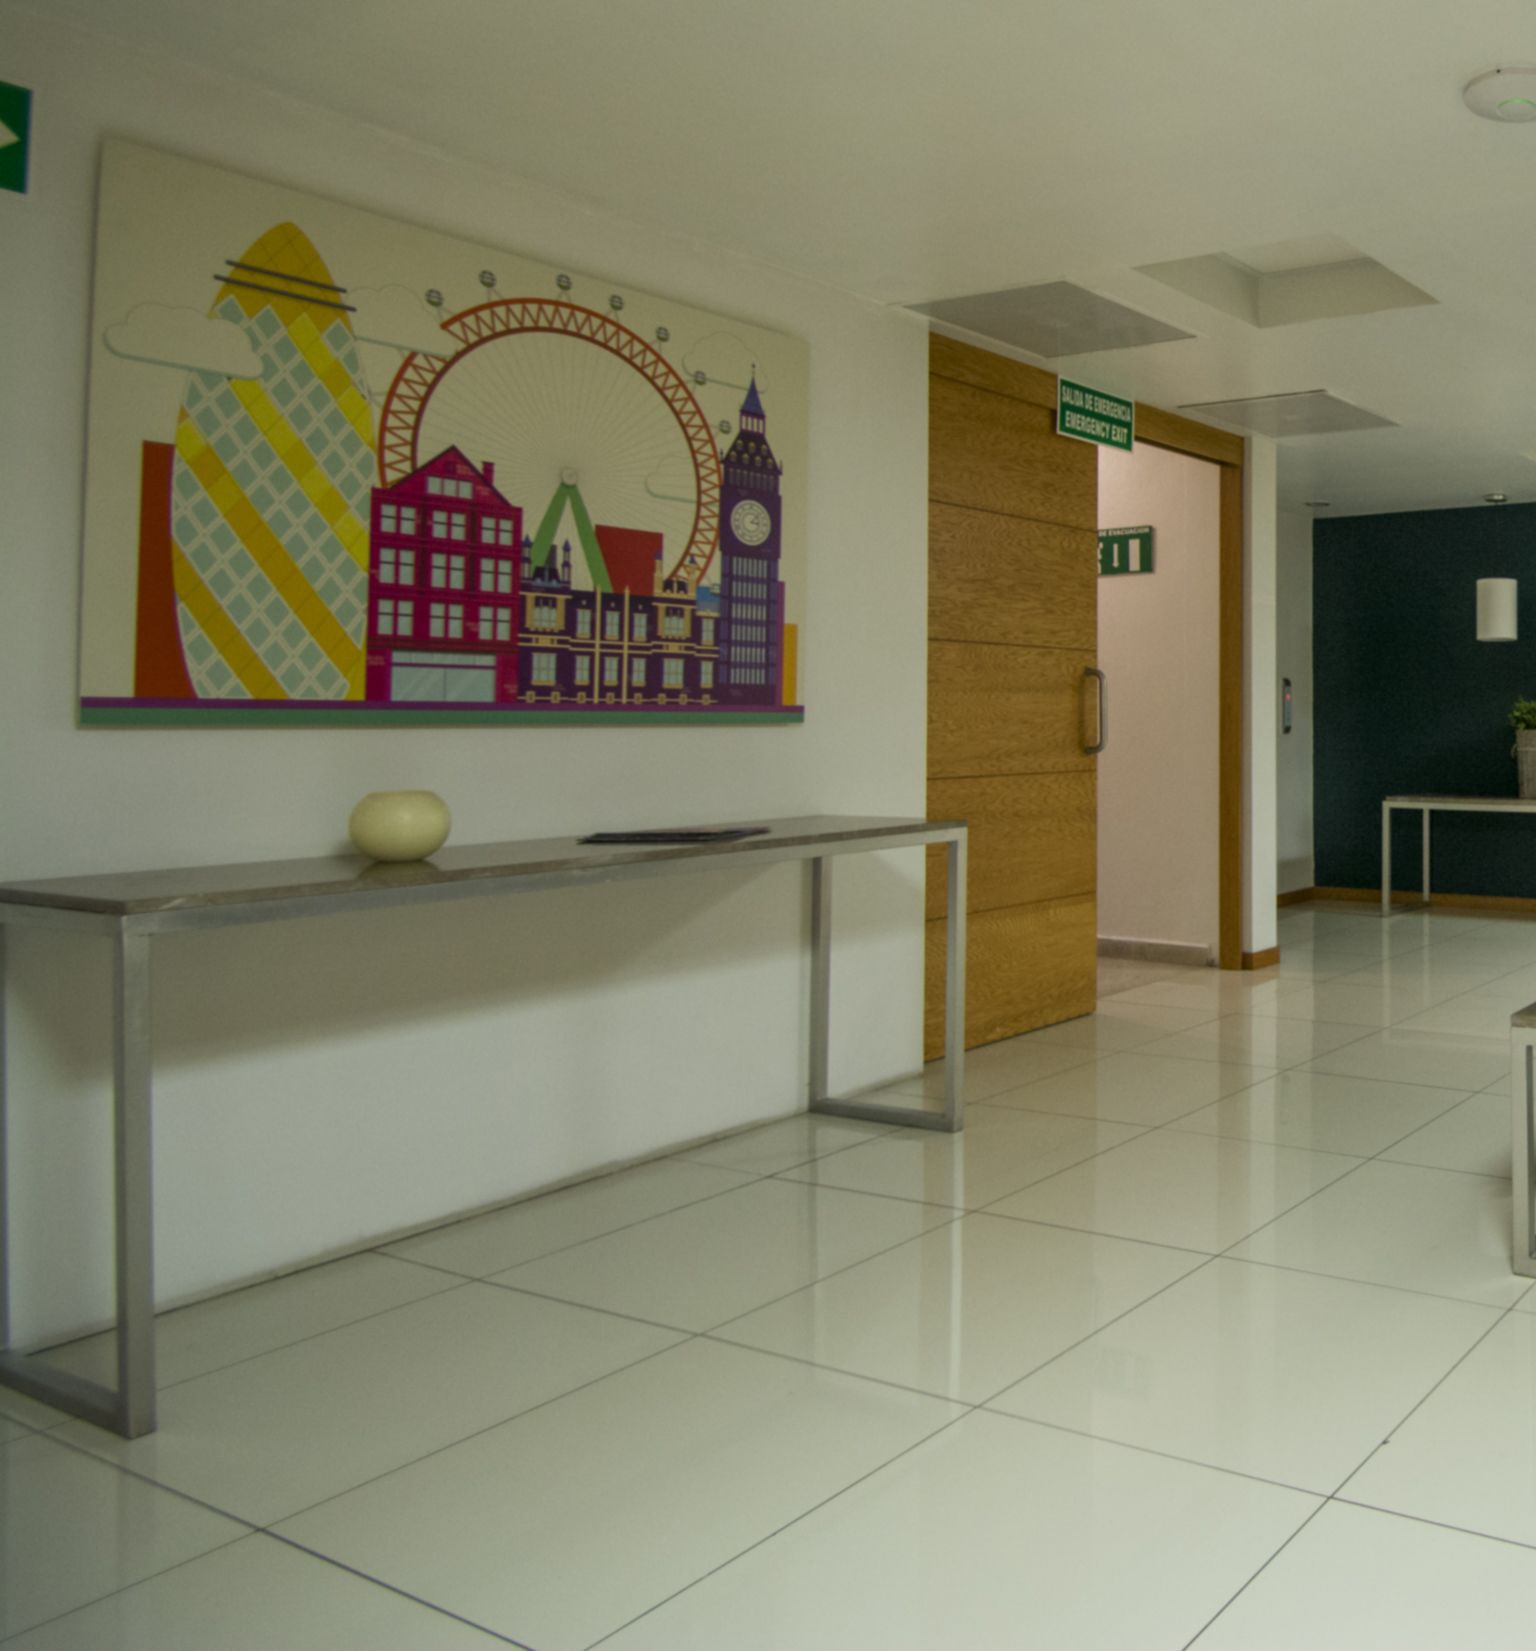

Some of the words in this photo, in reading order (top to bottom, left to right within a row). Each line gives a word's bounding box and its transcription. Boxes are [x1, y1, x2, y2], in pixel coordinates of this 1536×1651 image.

[1062, 385, 1084, 408] SALIDA
[1085, 392, 1094, 412] DE
[1094, 395, 1131, 422] EMERGENCIA
[1065, 410, 1111, 440] EMERGENCY
[1111, 424, 1128, 444] EXIT
